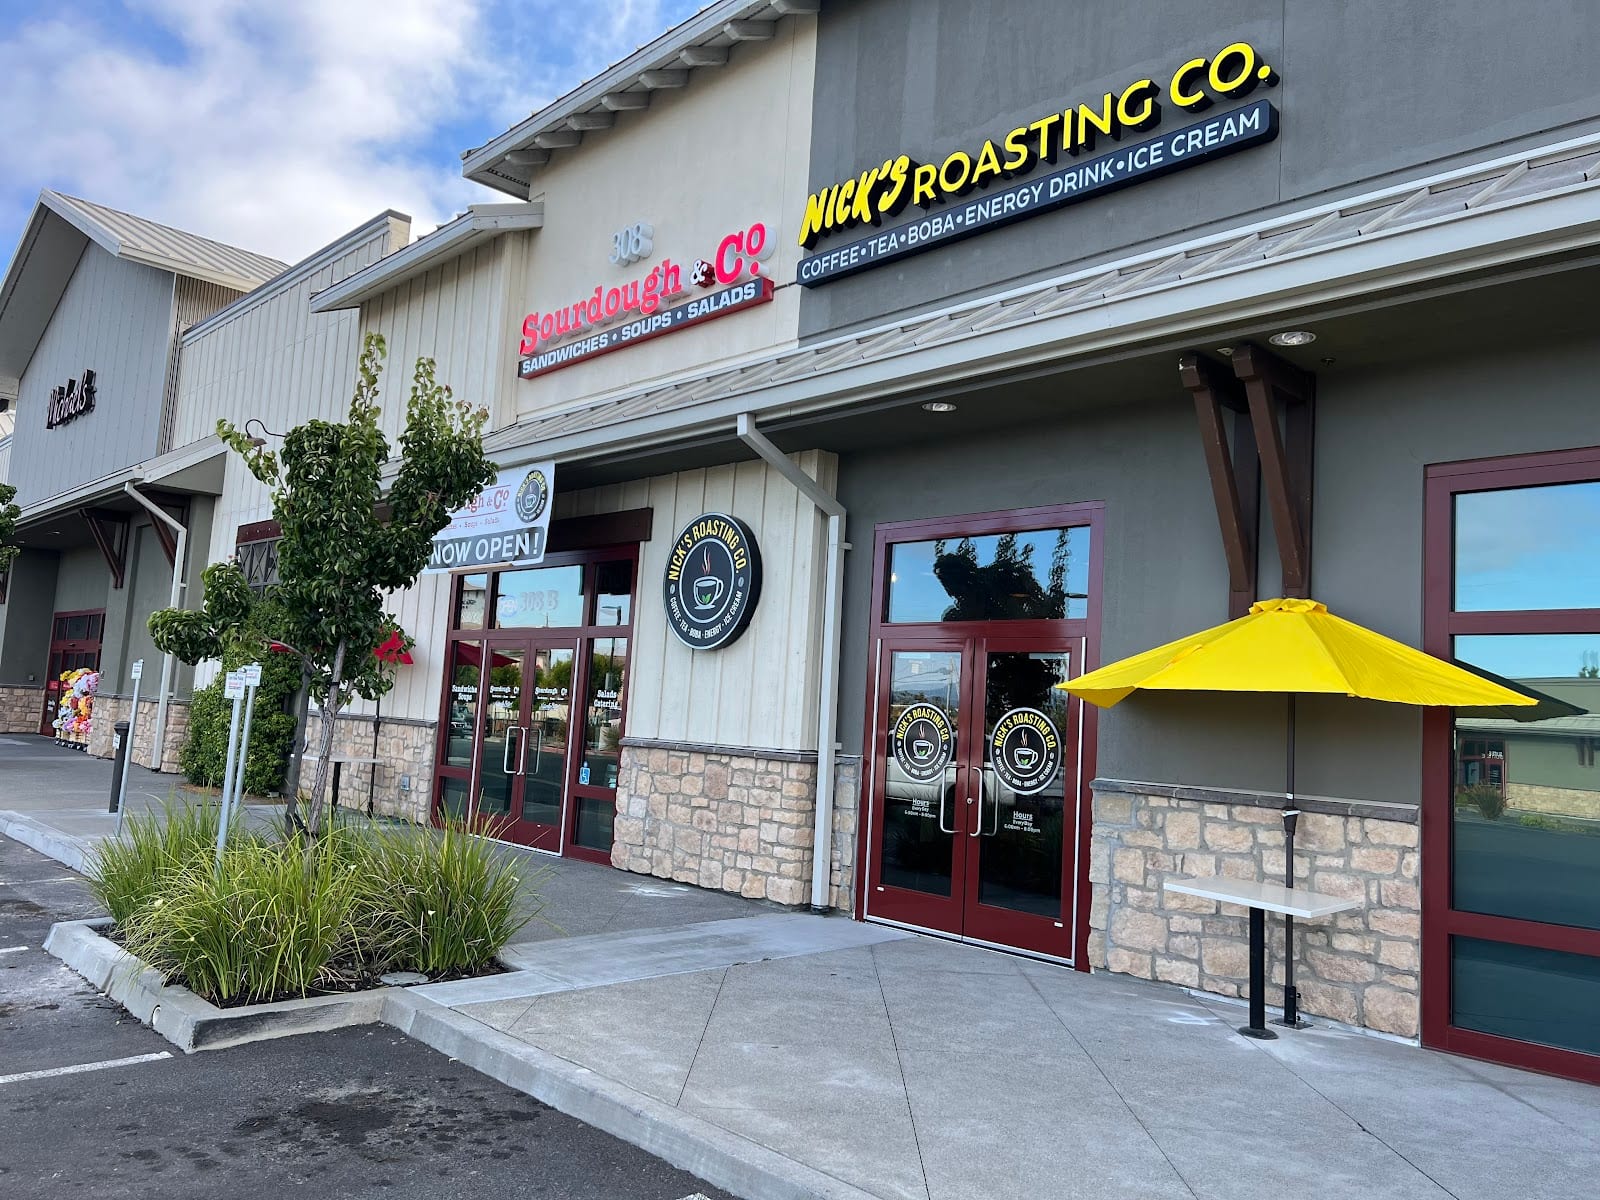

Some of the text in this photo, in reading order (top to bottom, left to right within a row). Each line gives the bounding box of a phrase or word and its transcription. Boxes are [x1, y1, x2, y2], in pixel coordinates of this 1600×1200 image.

[798, 42, 1272, 247] NICK'S ROASTING CO.
[802, 108, 1260, 280] COFFEE TEA BOBA ENERGY DRINK ICE CREAM
[610, 222, 648, 265] 308
[520, 258, 683, 356] Sourdough
[690, 260, 709, 286] &
[522, 282, 756, 375] SANDWICHES SOUPS SALADS
[430, 532, 540, 566] NOW OPEN!
[668, 520, 747, 581] NICK'S ROASTING CO.
[670, 598, 682, 621] COFFEE
[680, 620, 689, 633] TEA
[704, 622, 722, 639] ENERGY
[730, 590, 743, 616] CREAM
[896, 708, 950, 743] NICK'S ROASTING CO.
[994, 712, 1057, 751] NICK'S ROASTING CO.
[1014, 810, 1033, 820] Hours
